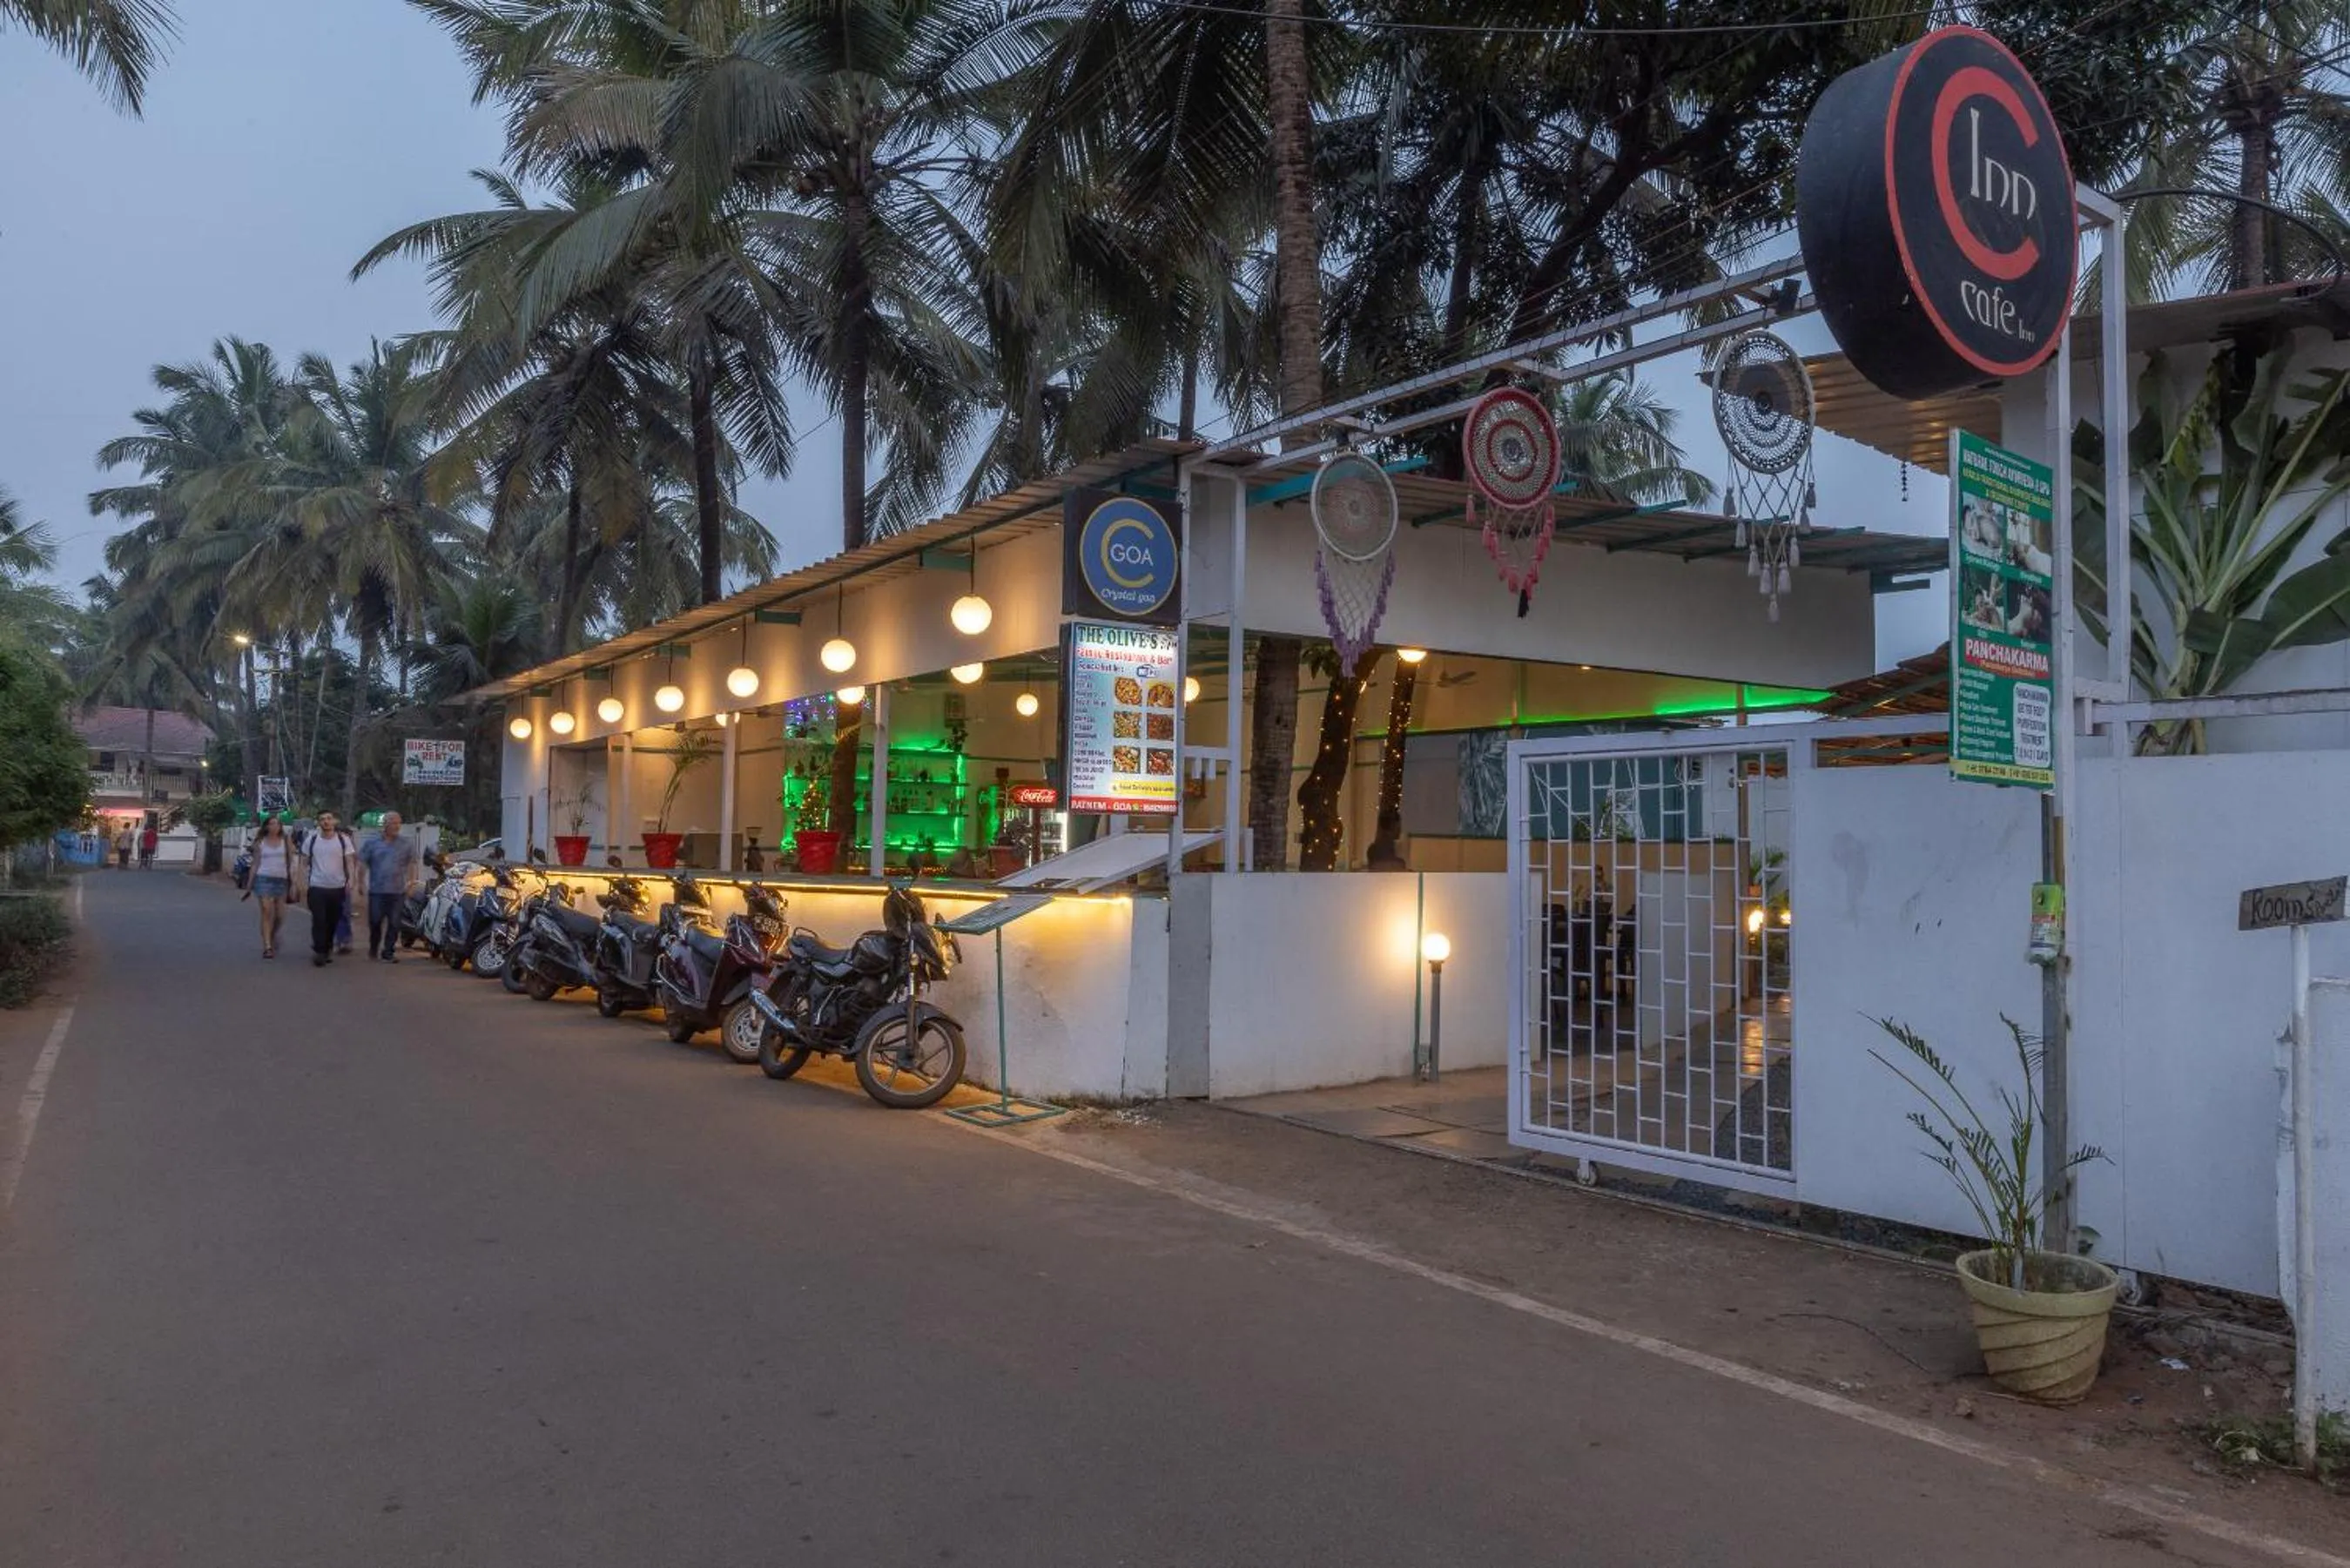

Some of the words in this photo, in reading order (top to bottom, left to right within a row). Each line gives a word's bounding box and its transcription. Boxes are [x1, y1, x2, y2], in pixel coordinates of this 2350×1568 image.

[1970, 107, 2036, 220] Inn
[1110, 543, 1154, 567] GOA
[1078, 626, 1103, 644] THE
[1965, 638, 2049, 672] PANCHAKARMA
[1113, 802, 1132, 811] GOA
